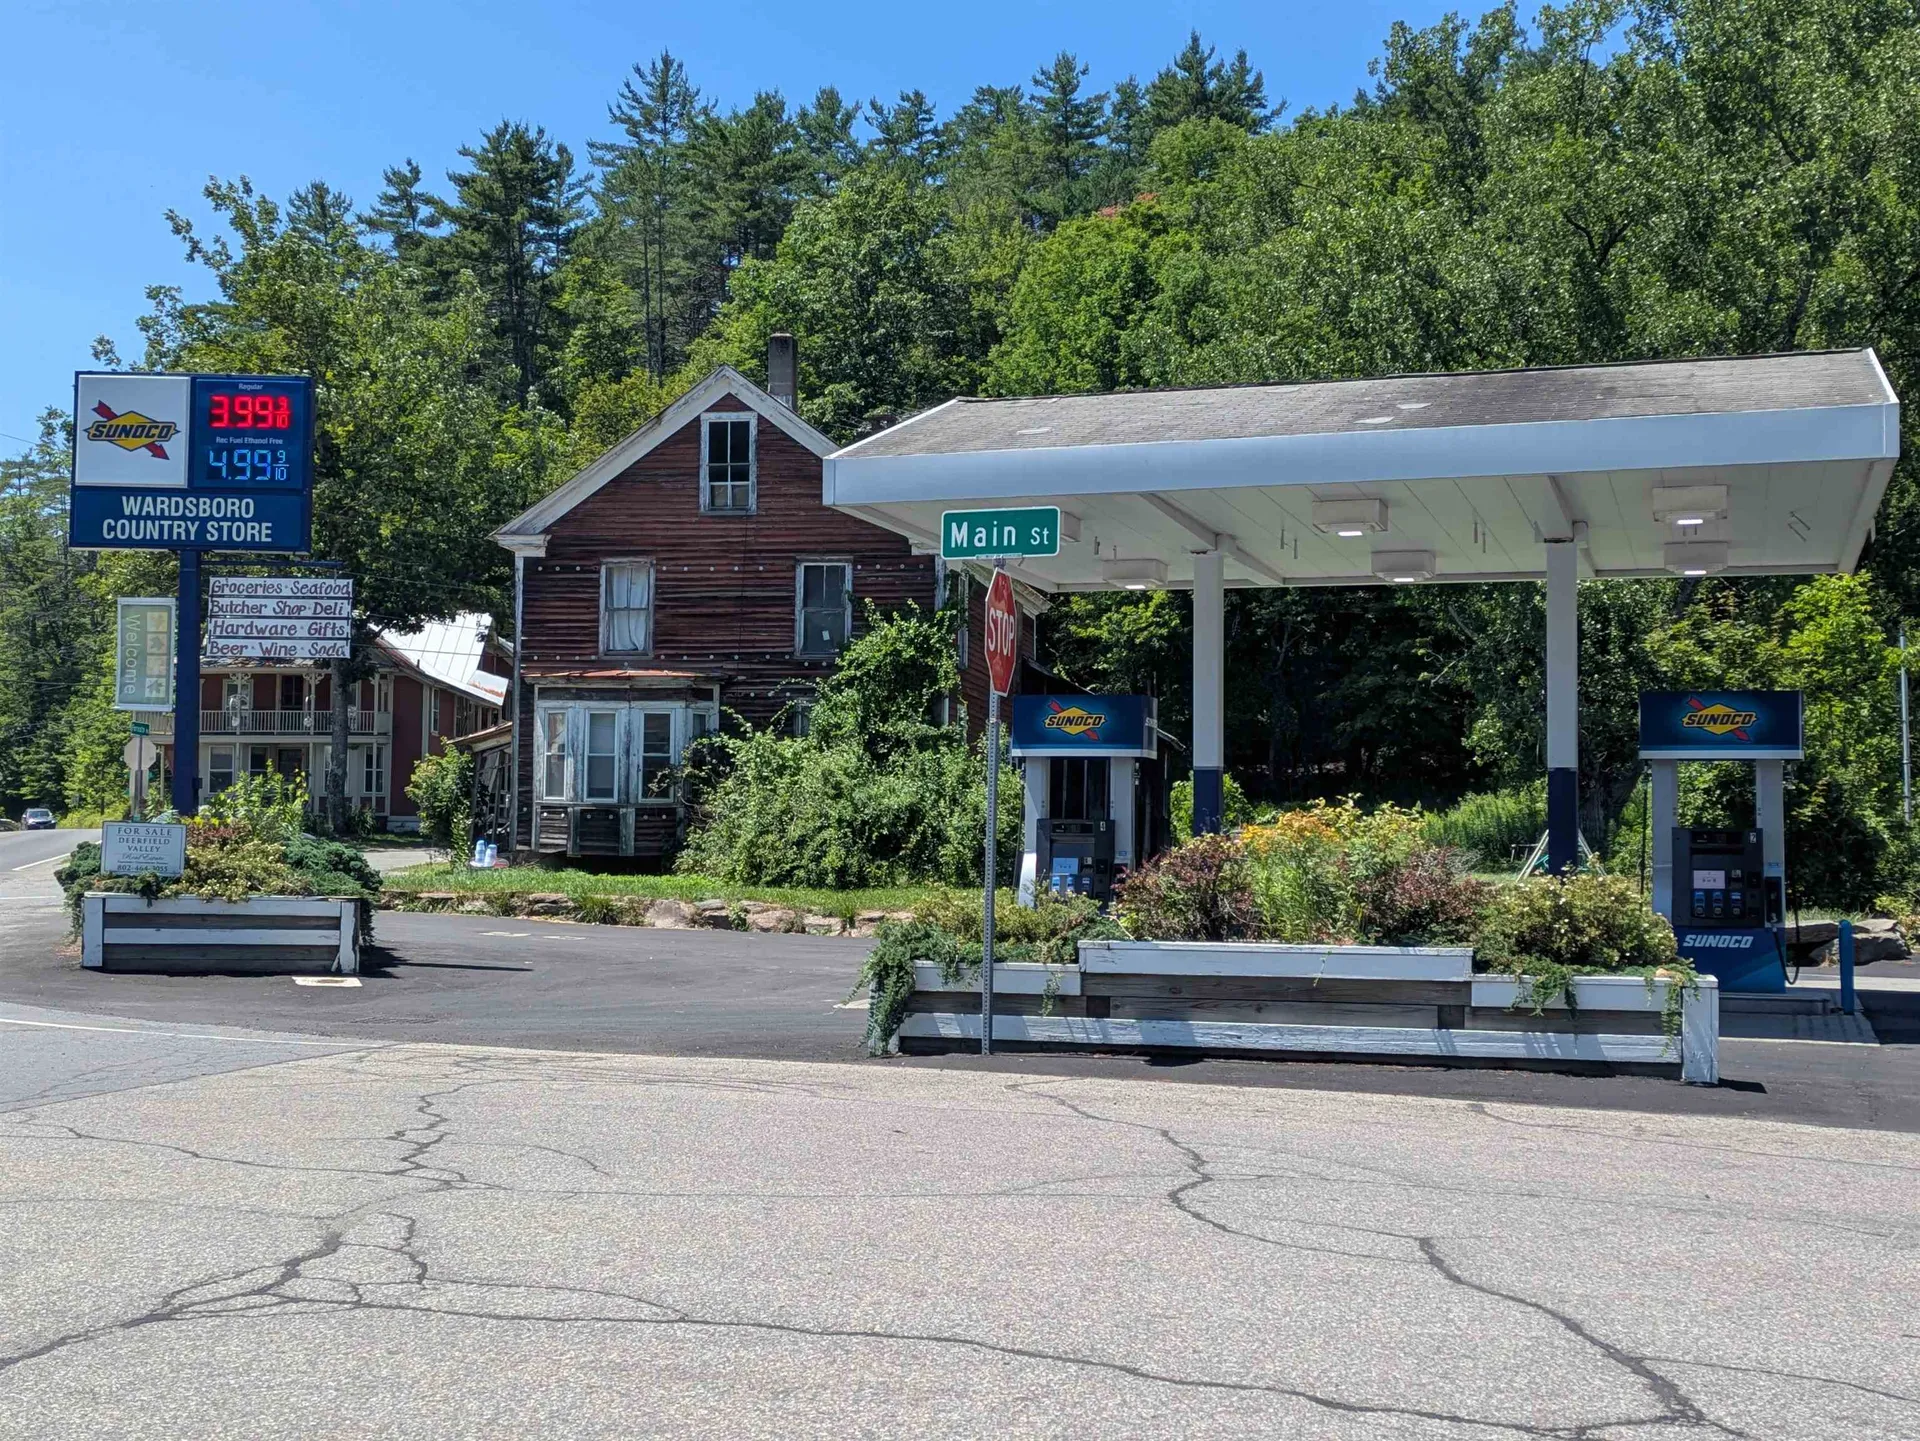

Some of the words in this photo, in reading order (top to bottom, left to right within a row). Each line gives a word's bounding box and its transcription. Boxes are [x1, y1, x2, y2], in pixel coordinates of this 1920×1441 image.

[238, 382, 263, 392] Regular
[210, 395, 273, 428] 3.99
[91, 423, 175, 440] SUNOCO
[216, 436, 228, 445] Rec
[229, 436, 243, 445] Fuel
[244, 436, 268, 446] Ethanol
[269, 437, 283, 446] Free
[209, 449, 271, 480] 4.99
[121, 495, 254, 519] WARDSBORO
[102, 519, 199, 541] COUNTRY
[206, 521, 272, 542] STORE
[950, 521, 1016, 548] Main
[1030, 527, 1050, 546] St
[211, 579, 283, 594] Groceries
[290, 580, 351, 595] Seafood
[211, 600, 267, 614] Butcher
[312, 602, 344, 615] Deli
[213, 620, 297, 636] Hardware
[307, 621, 346, 637] Gifts
[988, 607, 1015, 657] STOP
[124, 615, 141, 695] Welcome
[209, 641, 249, 655] Beer
[258, 642, 298, 656] Wine
[308, 642, 346, 657] Soda
[1045, 715, 1105, 728] SUNOCO
[1685, 713, 1756, 726] SUNOCO
[117, 827, 140, 835] FOR
[145, 827, 172, 836] SALE
[118, 837, 170, 845] DEERFIELD
[127, 845, 161, 853] VALLEY
[1682, 934, 1754, 949] SUNOCO
